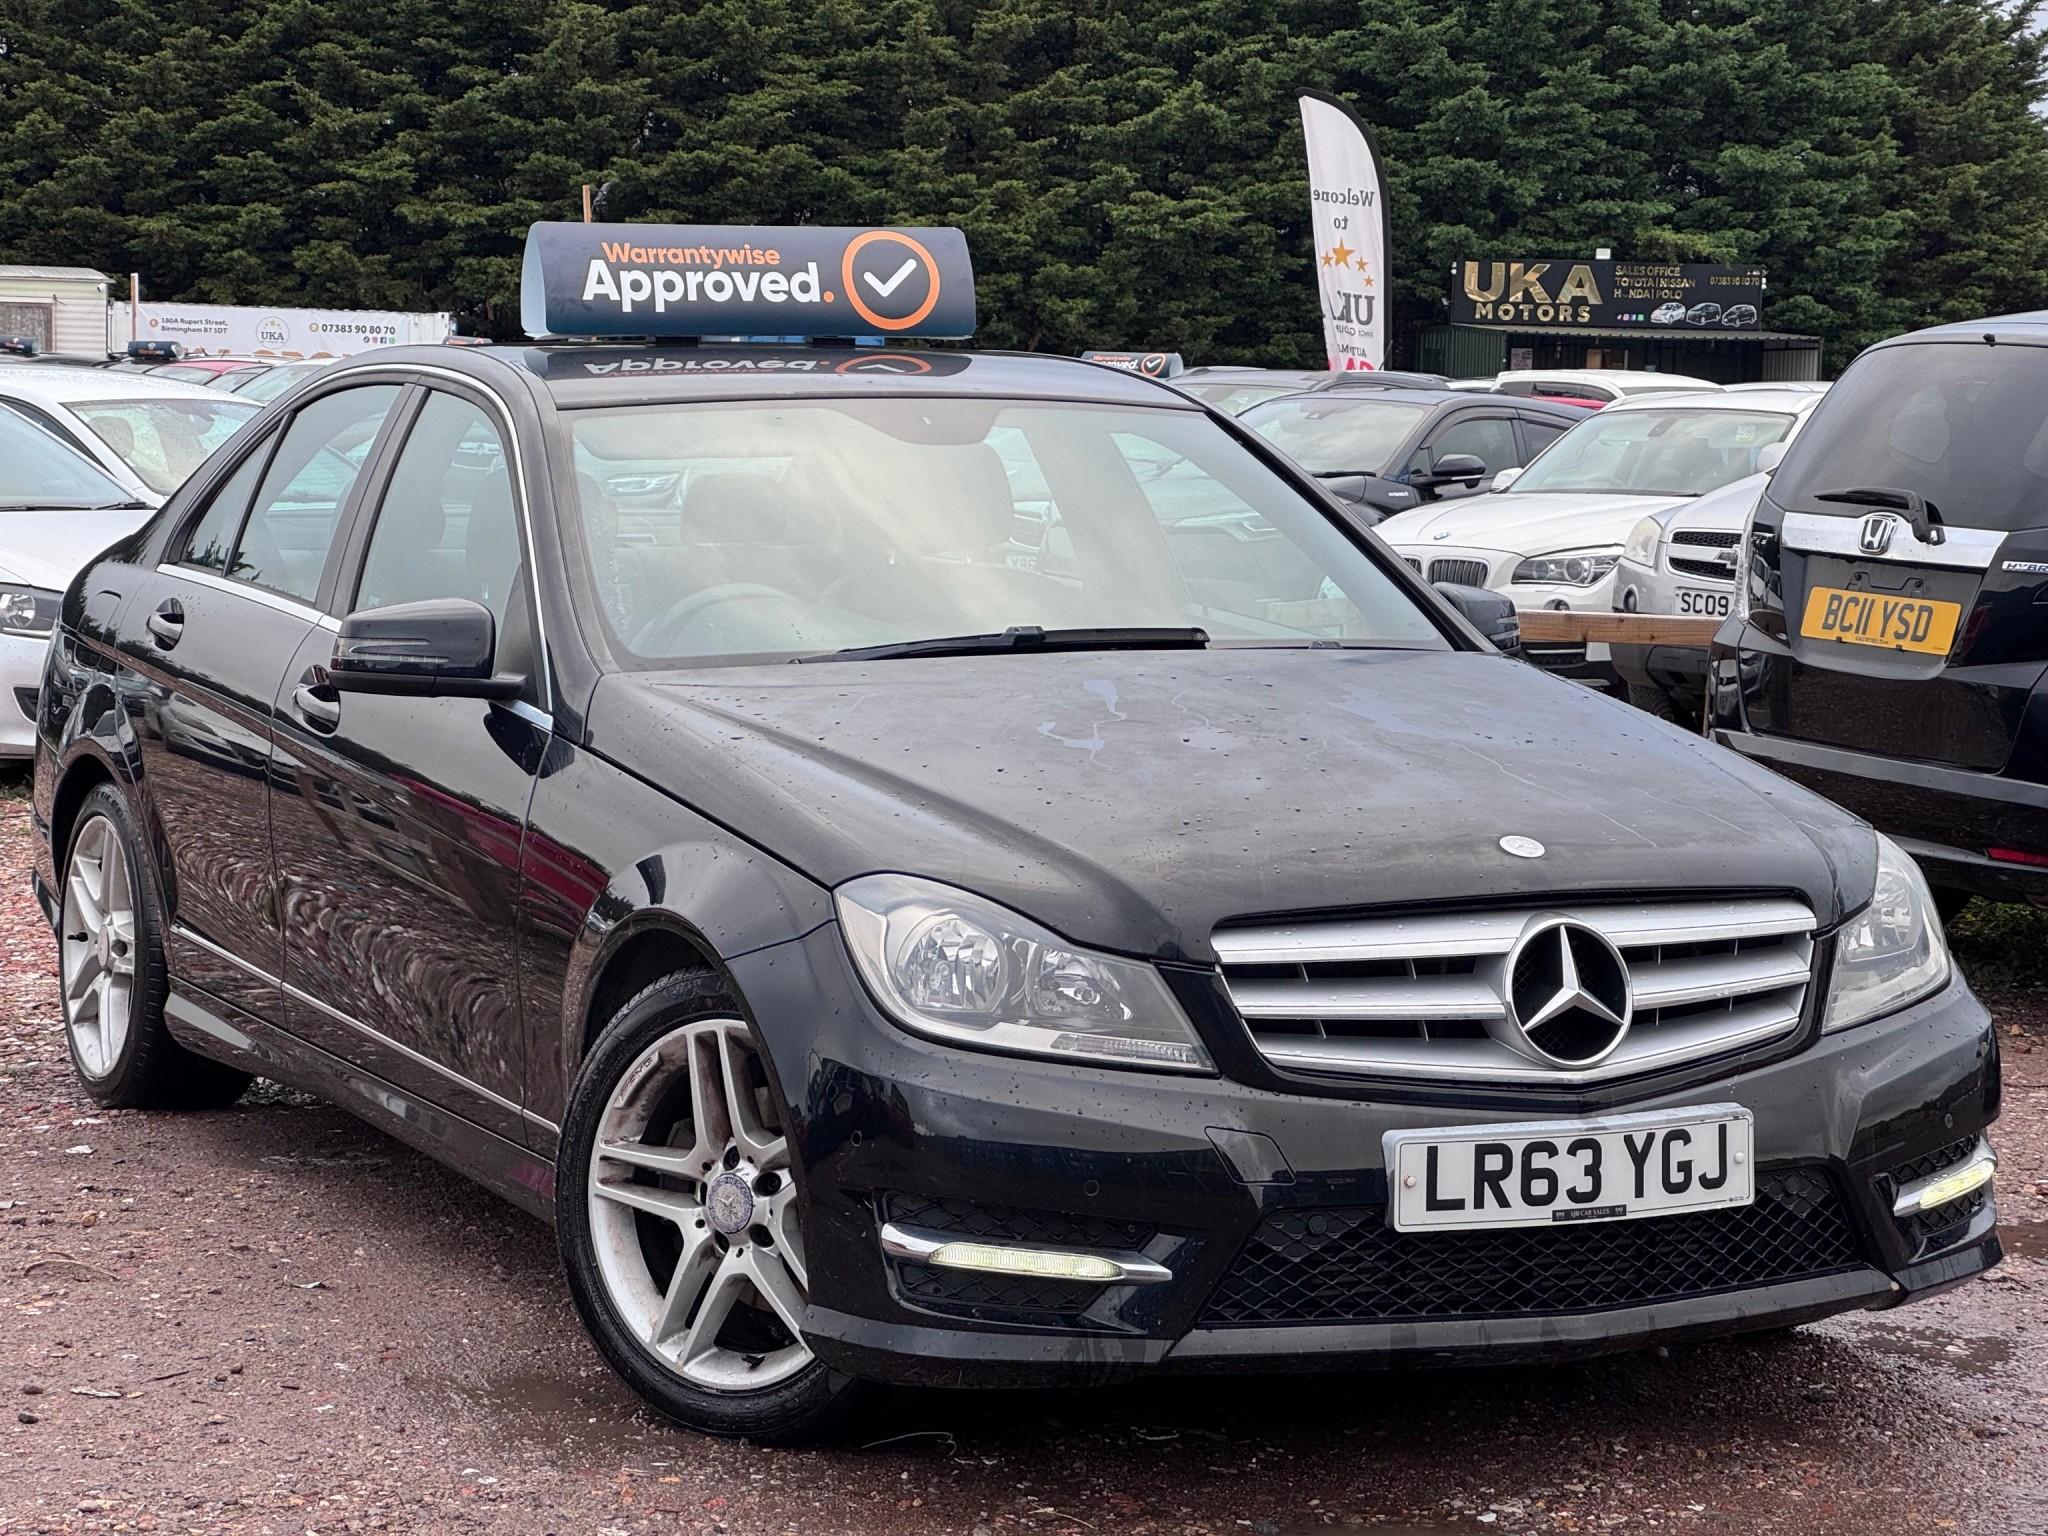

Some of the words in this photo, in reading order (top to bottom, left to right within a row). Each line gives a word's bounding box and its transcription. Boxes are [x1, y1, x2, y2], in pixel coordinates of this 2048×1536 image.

[601, 242, 781, 269] Warrantywise
[1615, 265, 1646, 275] SALES
[1646, 265, 1681, 276] OFFICE
[582, 259, 834, 312] Approved.
[1464, 261, 1603, 304] UKA
[1615, 277, 1655, 287] TOYOTA
[1660, 278, 1696, 287] NISSAN
[1656, 289, 1683, 299] POLO
[1475, 303, 1591, 323] MOTORS
[161, 325, 202, 334] Birmingham
[179, 317, 203, 326] Rupert
[321, 323, 352, 333] 07383
[354, 324, 367, 334] 90
[369, 326, 381, 335] 80
[383, 326, 396, 335] 70
[261, 331, 285, 340] UKA
[1681, 592, 1729, 616] SC09
[1822, 593, 1876, 635] BC11
[1880, 600, 1934, 642] YSD
[1426, 1138, 1602, 1212] LR63
[1623, 1123, 1727, 1199] YGJ
